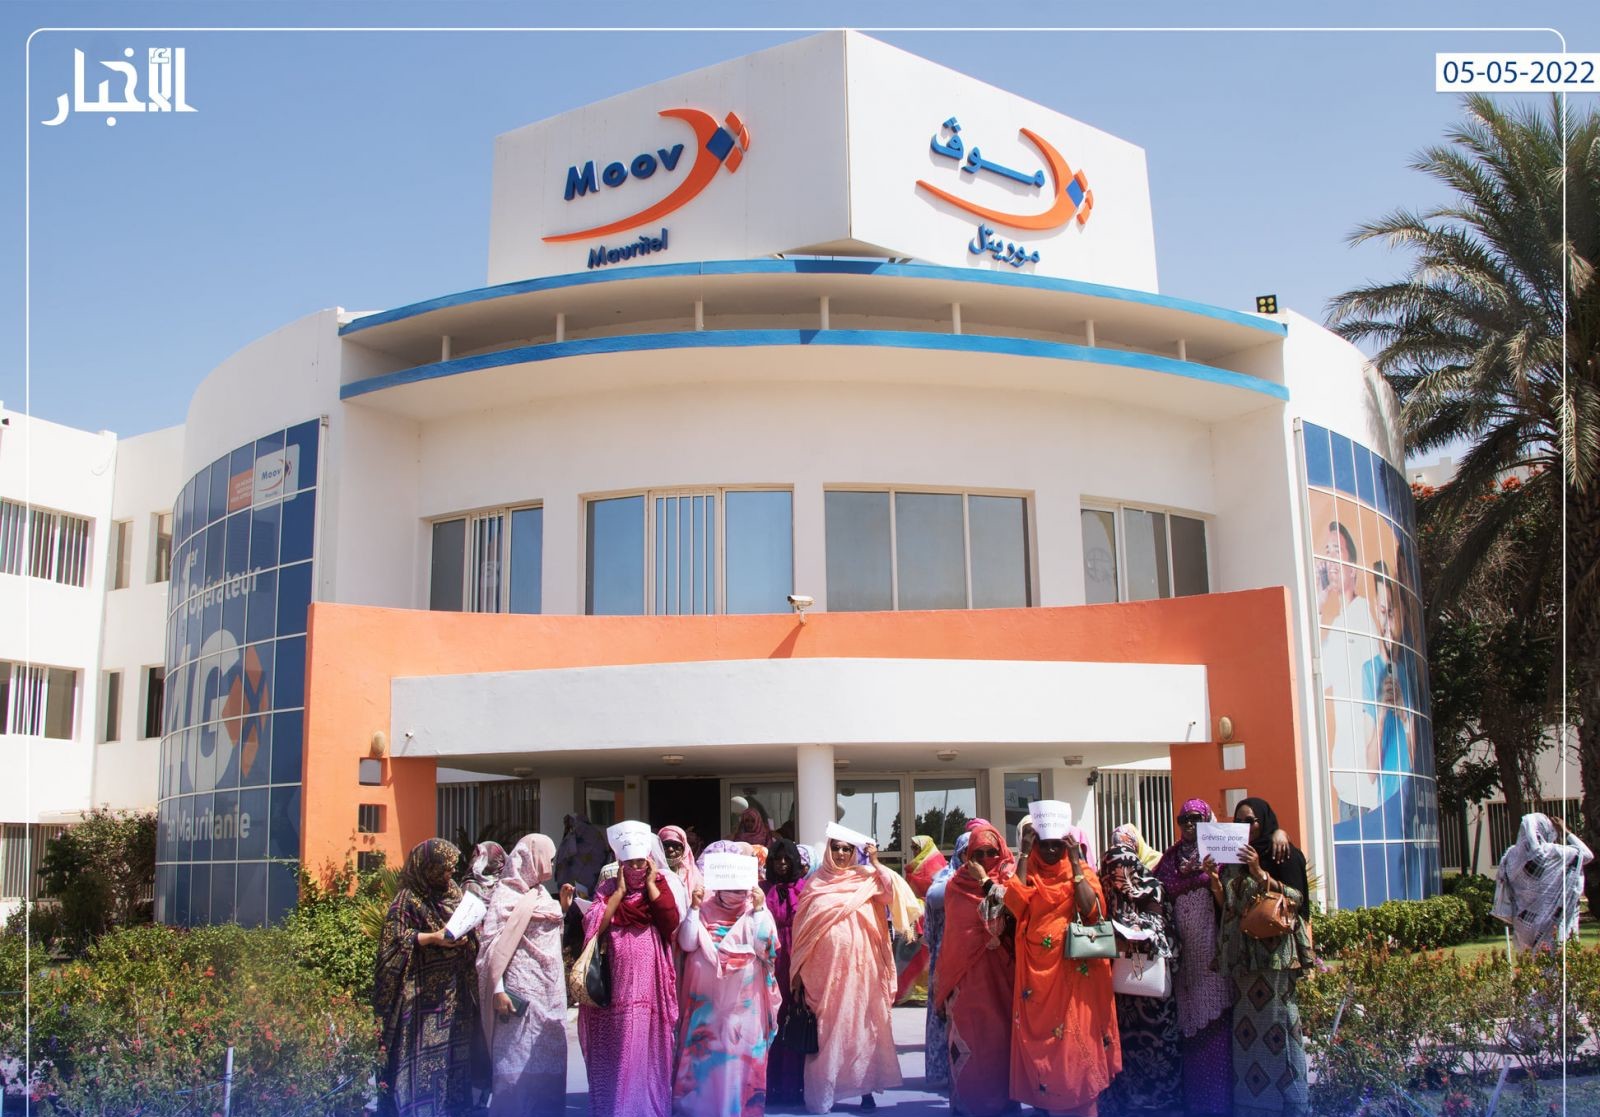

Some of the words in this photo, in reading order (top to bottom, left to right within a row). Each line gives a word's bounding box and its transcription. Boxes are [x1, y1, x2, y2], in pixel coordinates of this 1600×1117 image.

[564, 144, 685, 201] Moov
[587, 228, 669, 269] Mauritel
[968, 223, 1041, 268] موريتل
[261, 469, 282, 480] Moov
[177, 803, 251, 843] Mauritanie
